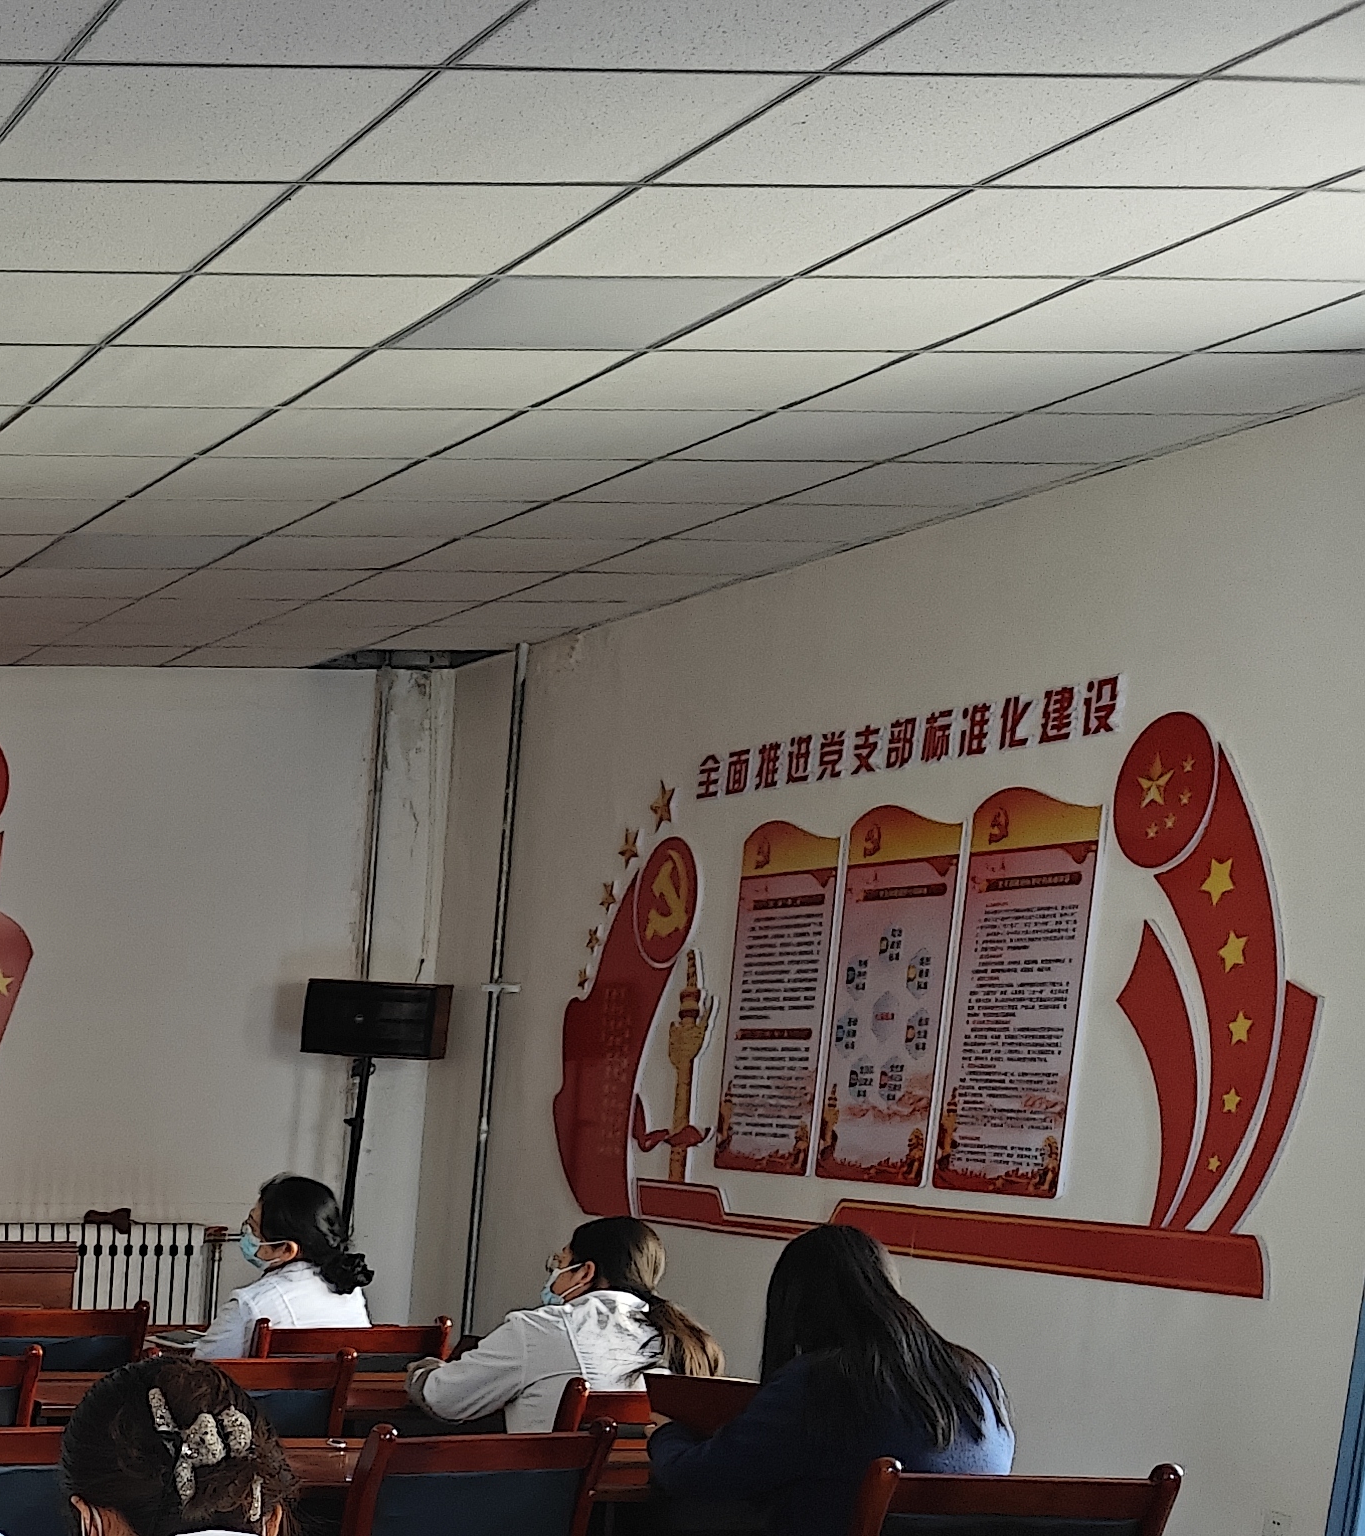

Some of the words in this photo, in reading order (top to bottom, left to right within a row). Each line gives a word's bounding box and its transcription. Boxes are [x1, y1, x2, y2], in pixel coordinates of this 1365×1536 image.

[696, 673, 1122, 801] 全面推进党支部标准化建设
